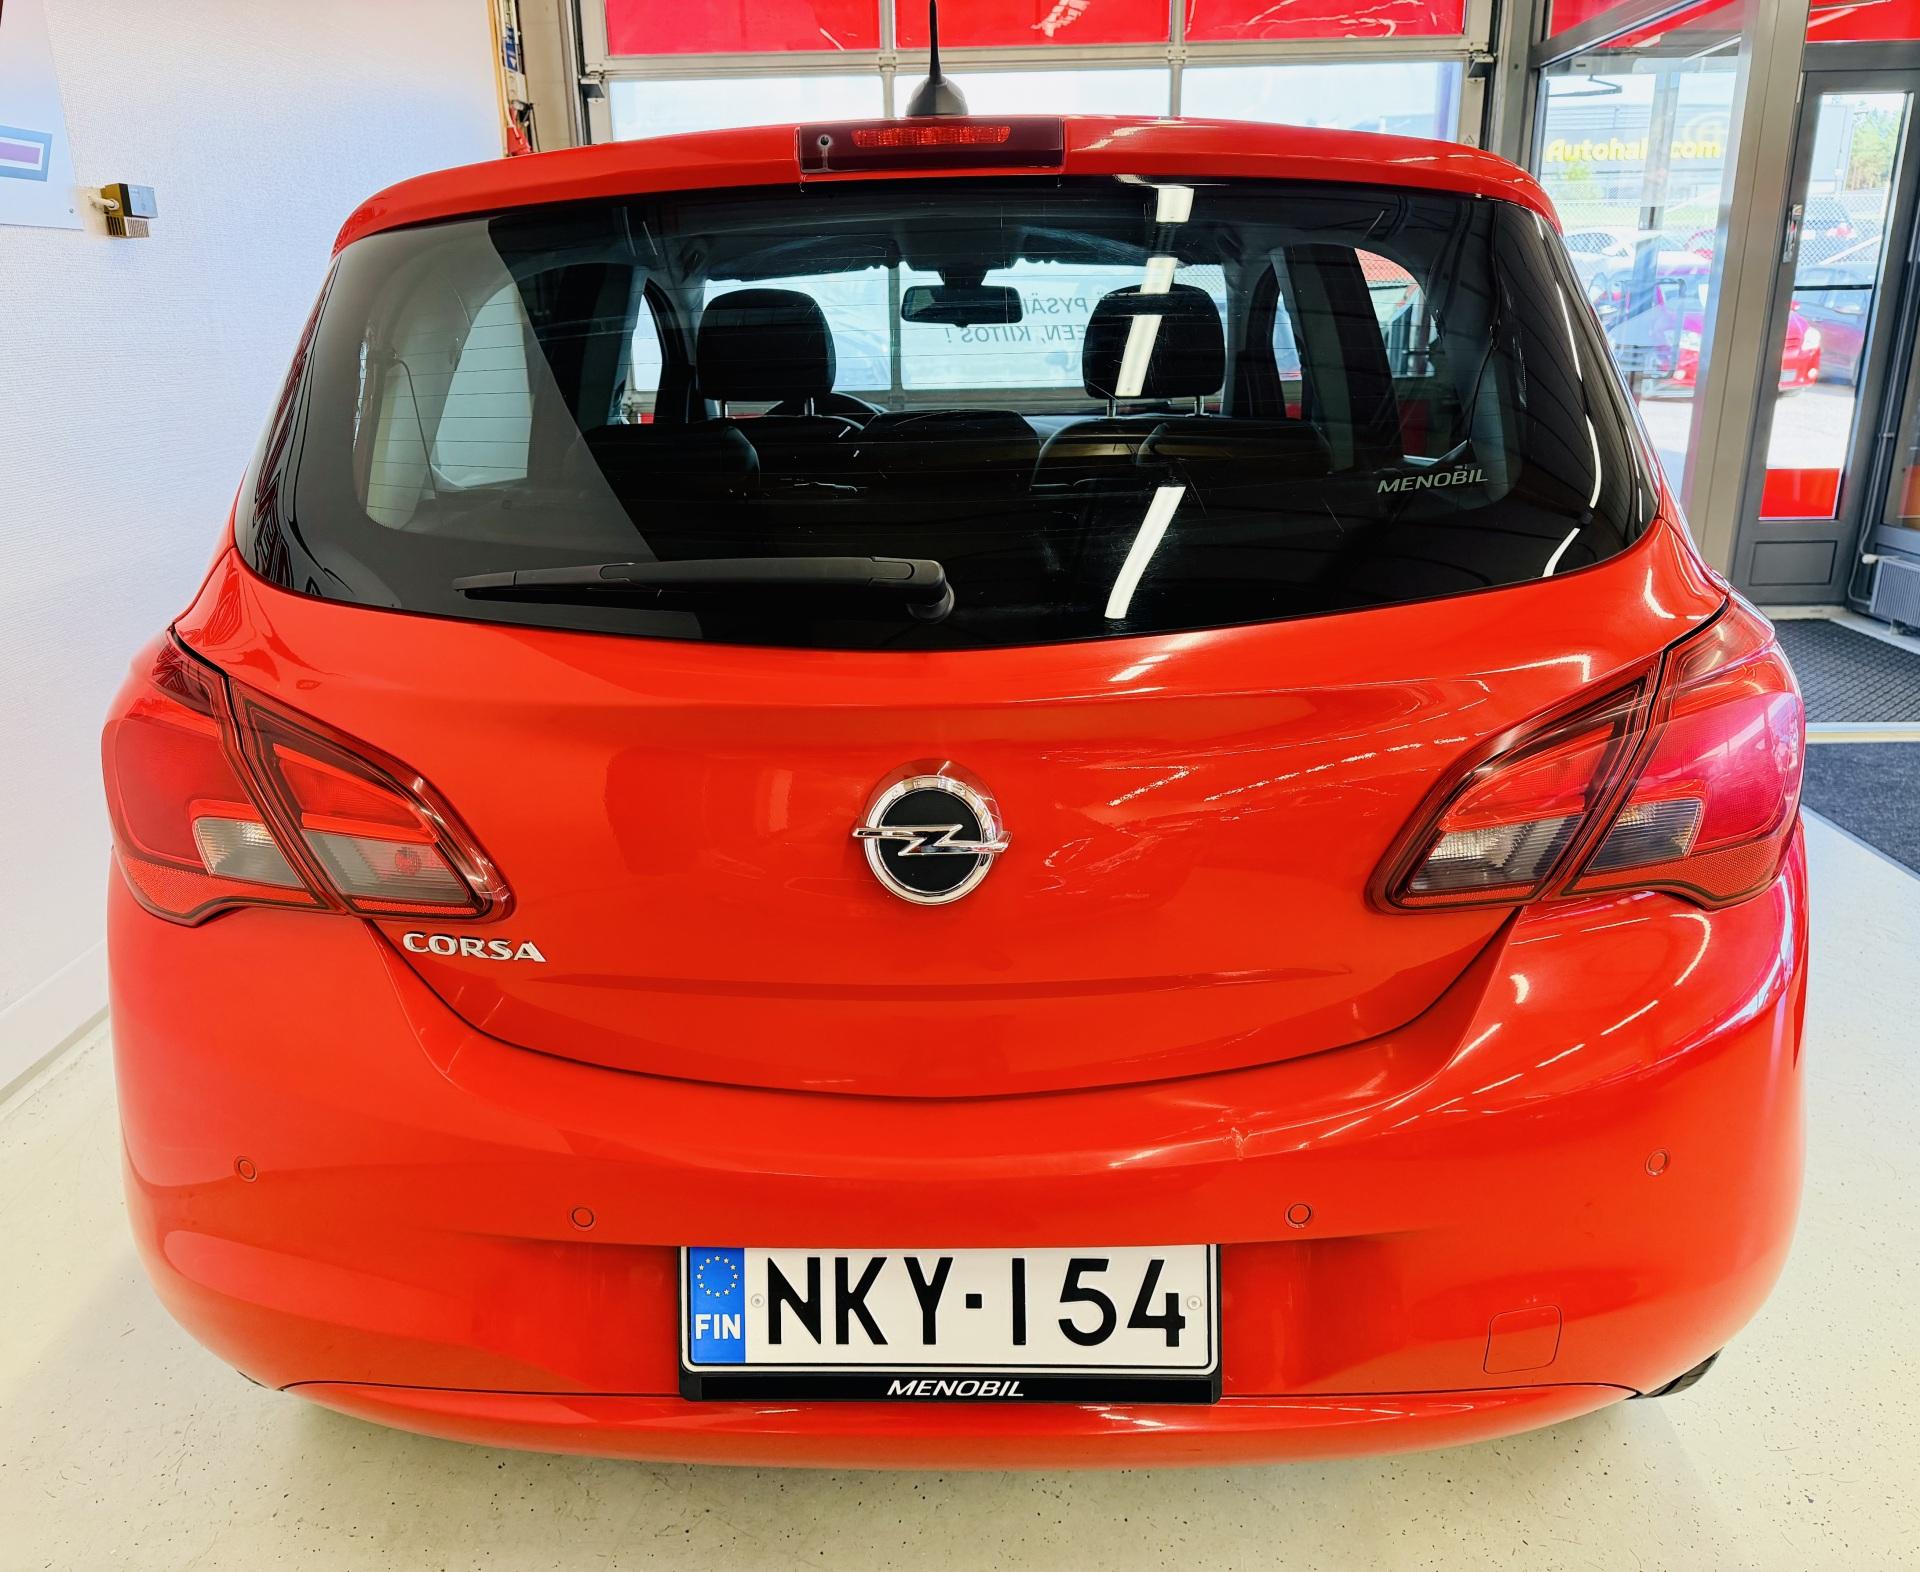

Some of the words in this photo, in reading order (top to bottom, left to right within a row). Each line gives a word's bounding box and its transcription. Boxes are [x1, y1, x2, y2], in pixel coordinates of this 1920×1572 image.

[1377, 469, 1488, 494] MENOBIL
[402, 931, 546, 962] CORSA
[695, 1314, 741, 1341] FIN
[886, 1379, 1024, 1397] MENOBIL
